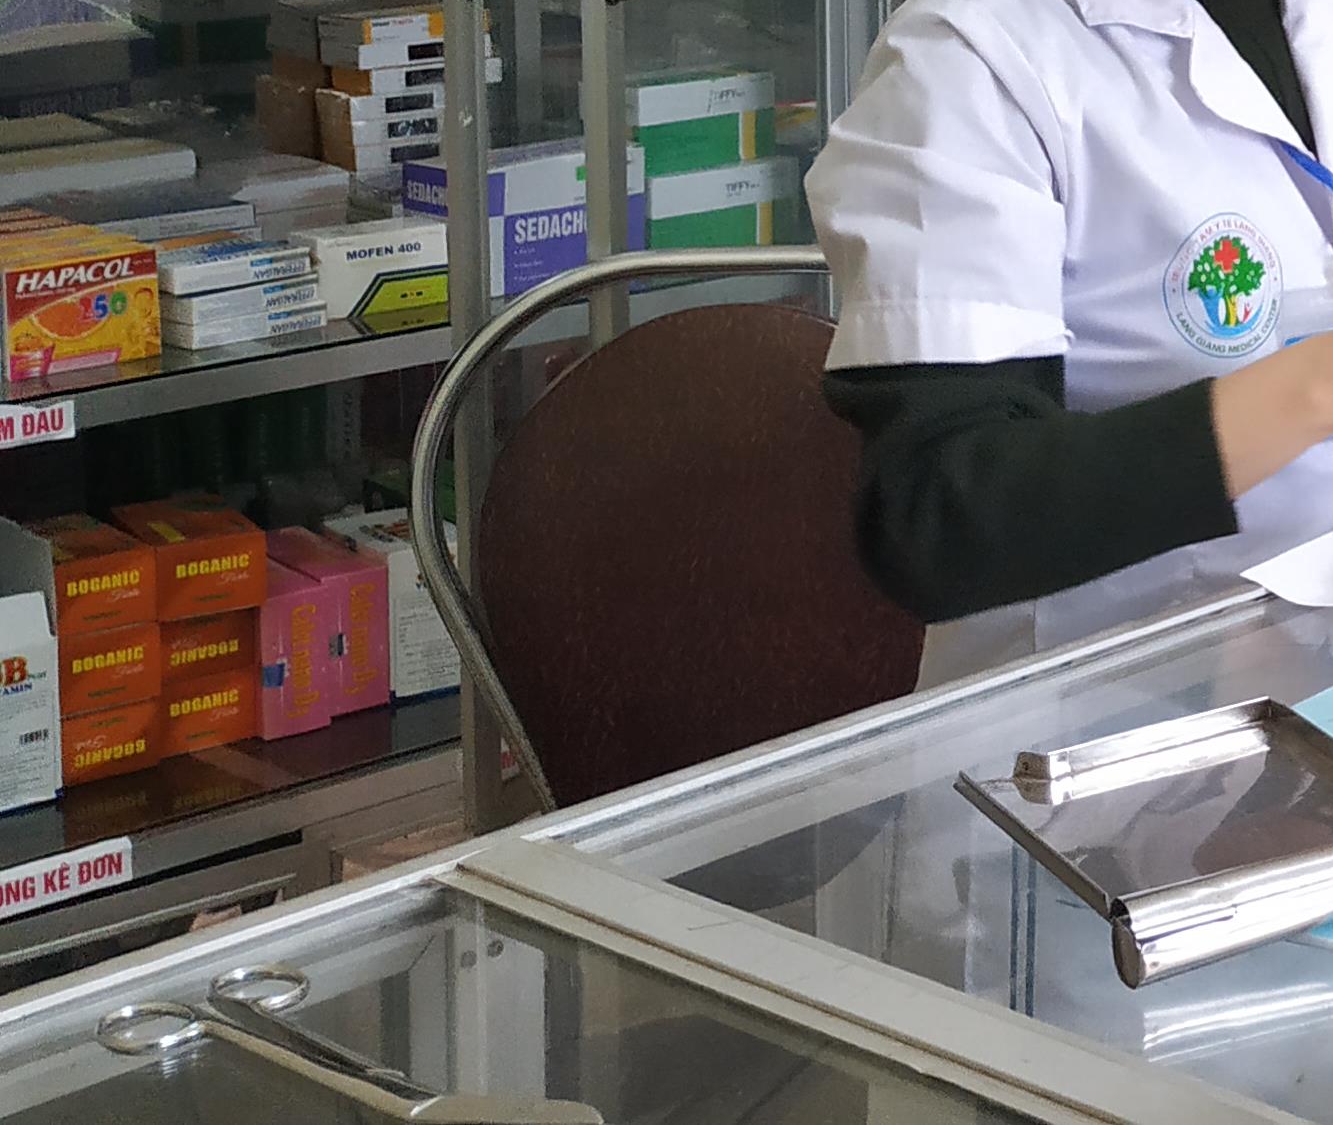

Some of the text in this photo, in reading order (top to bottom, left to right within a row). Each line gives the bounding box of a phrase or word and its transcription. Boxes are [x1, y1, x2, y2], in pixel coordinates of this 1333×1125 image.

[407, 180, 448, 206] SEDACH
[514, 210, 587, 244] SEDACH
[345, 241, 421, 261] MOFEN 400
[16, 258, 133, 293] HAPACOL
[22, 407, 64, 436] ĐAU
[176, 554, 249, 578] BOGANIC
[66, 570, 140, 598] BOGANIC
[71, 647, 143, 674] BOGANIC
[0, 681, 32, 696] AMIN
[170, 689, 239, 717] BOGANIC
[44, 862, 70, 894] KÊ
[78, 852, 122, 885] ĐƠN
